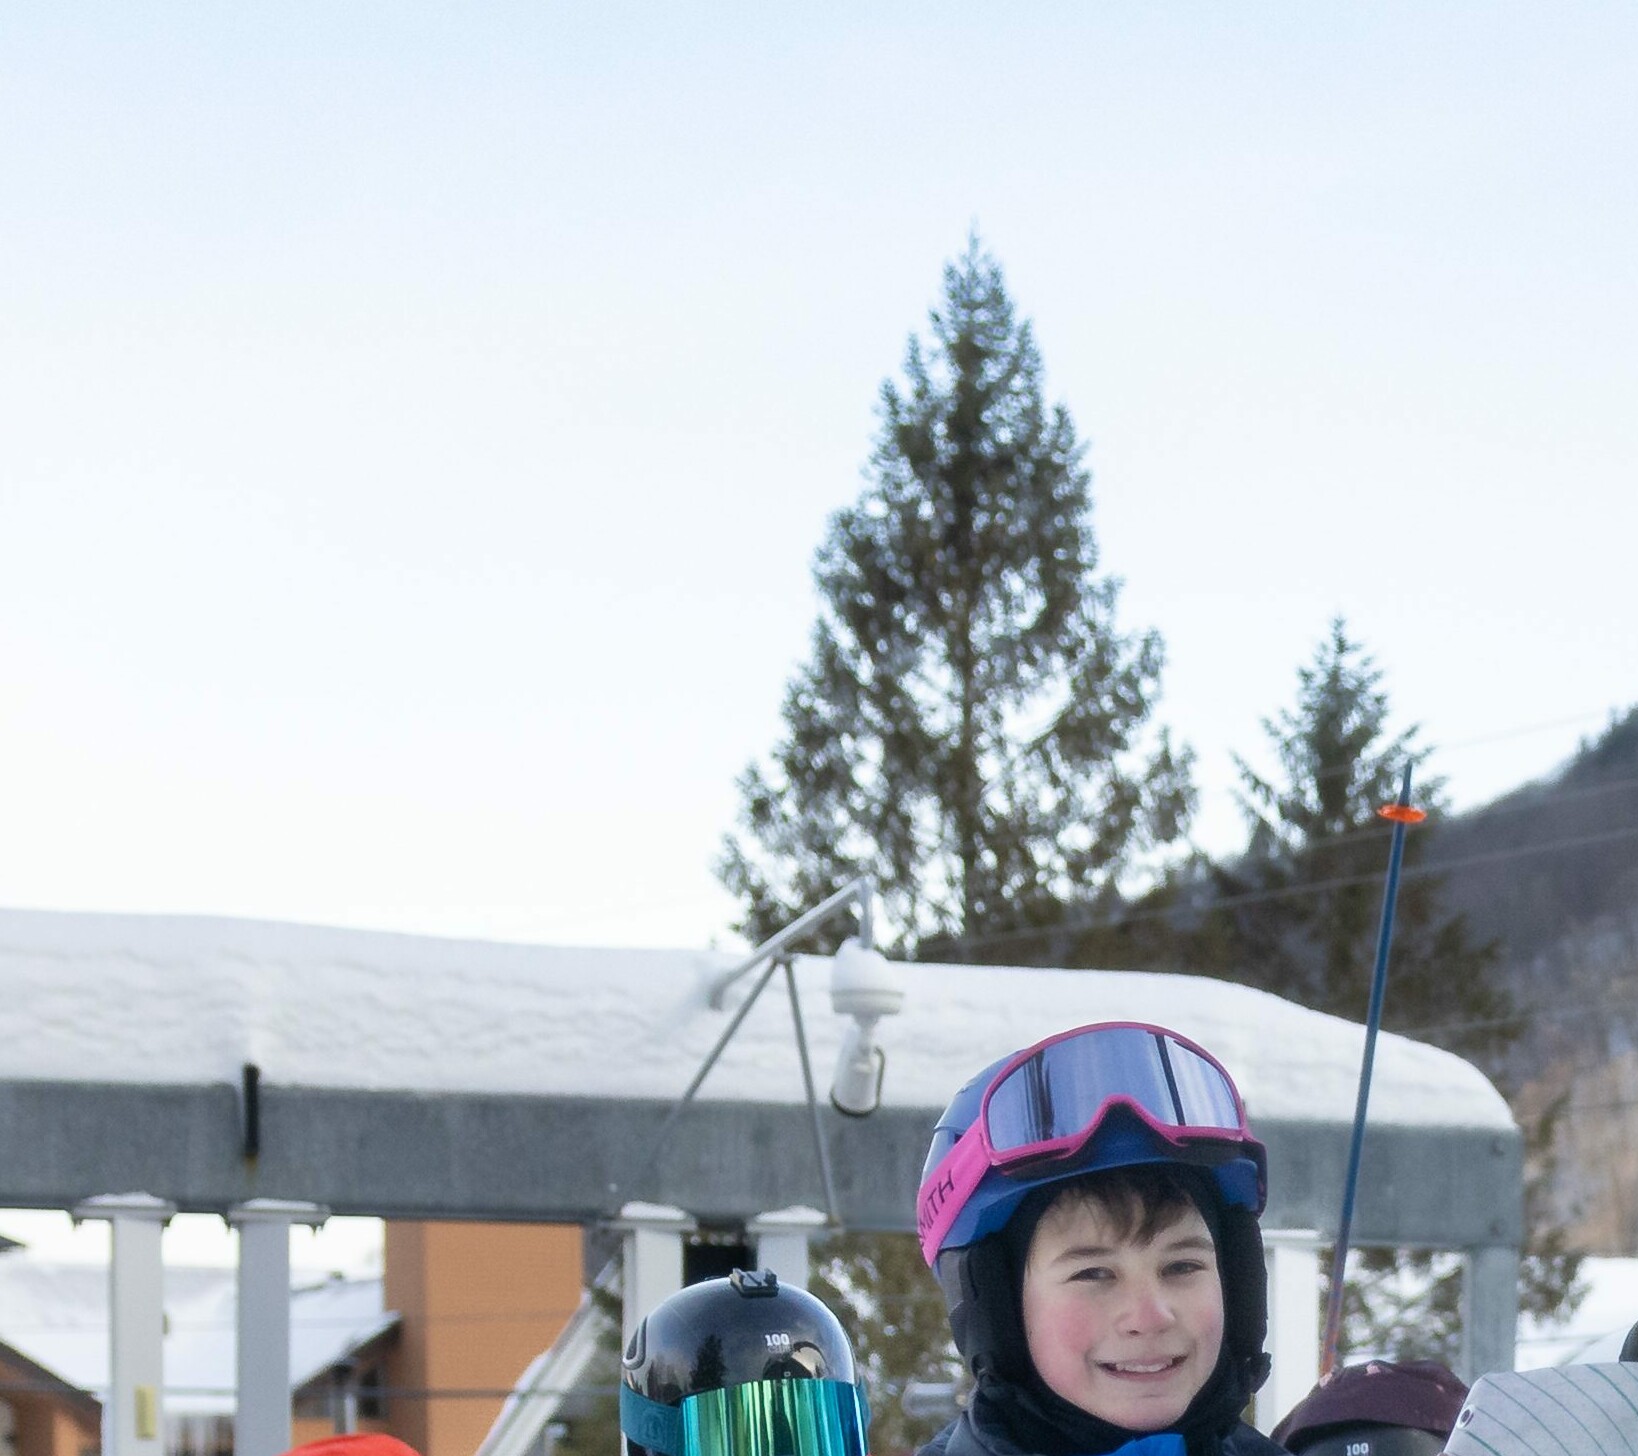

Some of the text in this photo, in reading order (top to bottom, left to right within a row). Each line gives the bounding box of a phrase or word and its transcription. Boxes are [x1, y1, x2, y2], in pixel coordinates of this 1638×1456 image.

[917, 1168, 955, 1247] MITH
[764, 1333, 790, 1347] 100
[1347, 1442, 1369, 1456] 100
